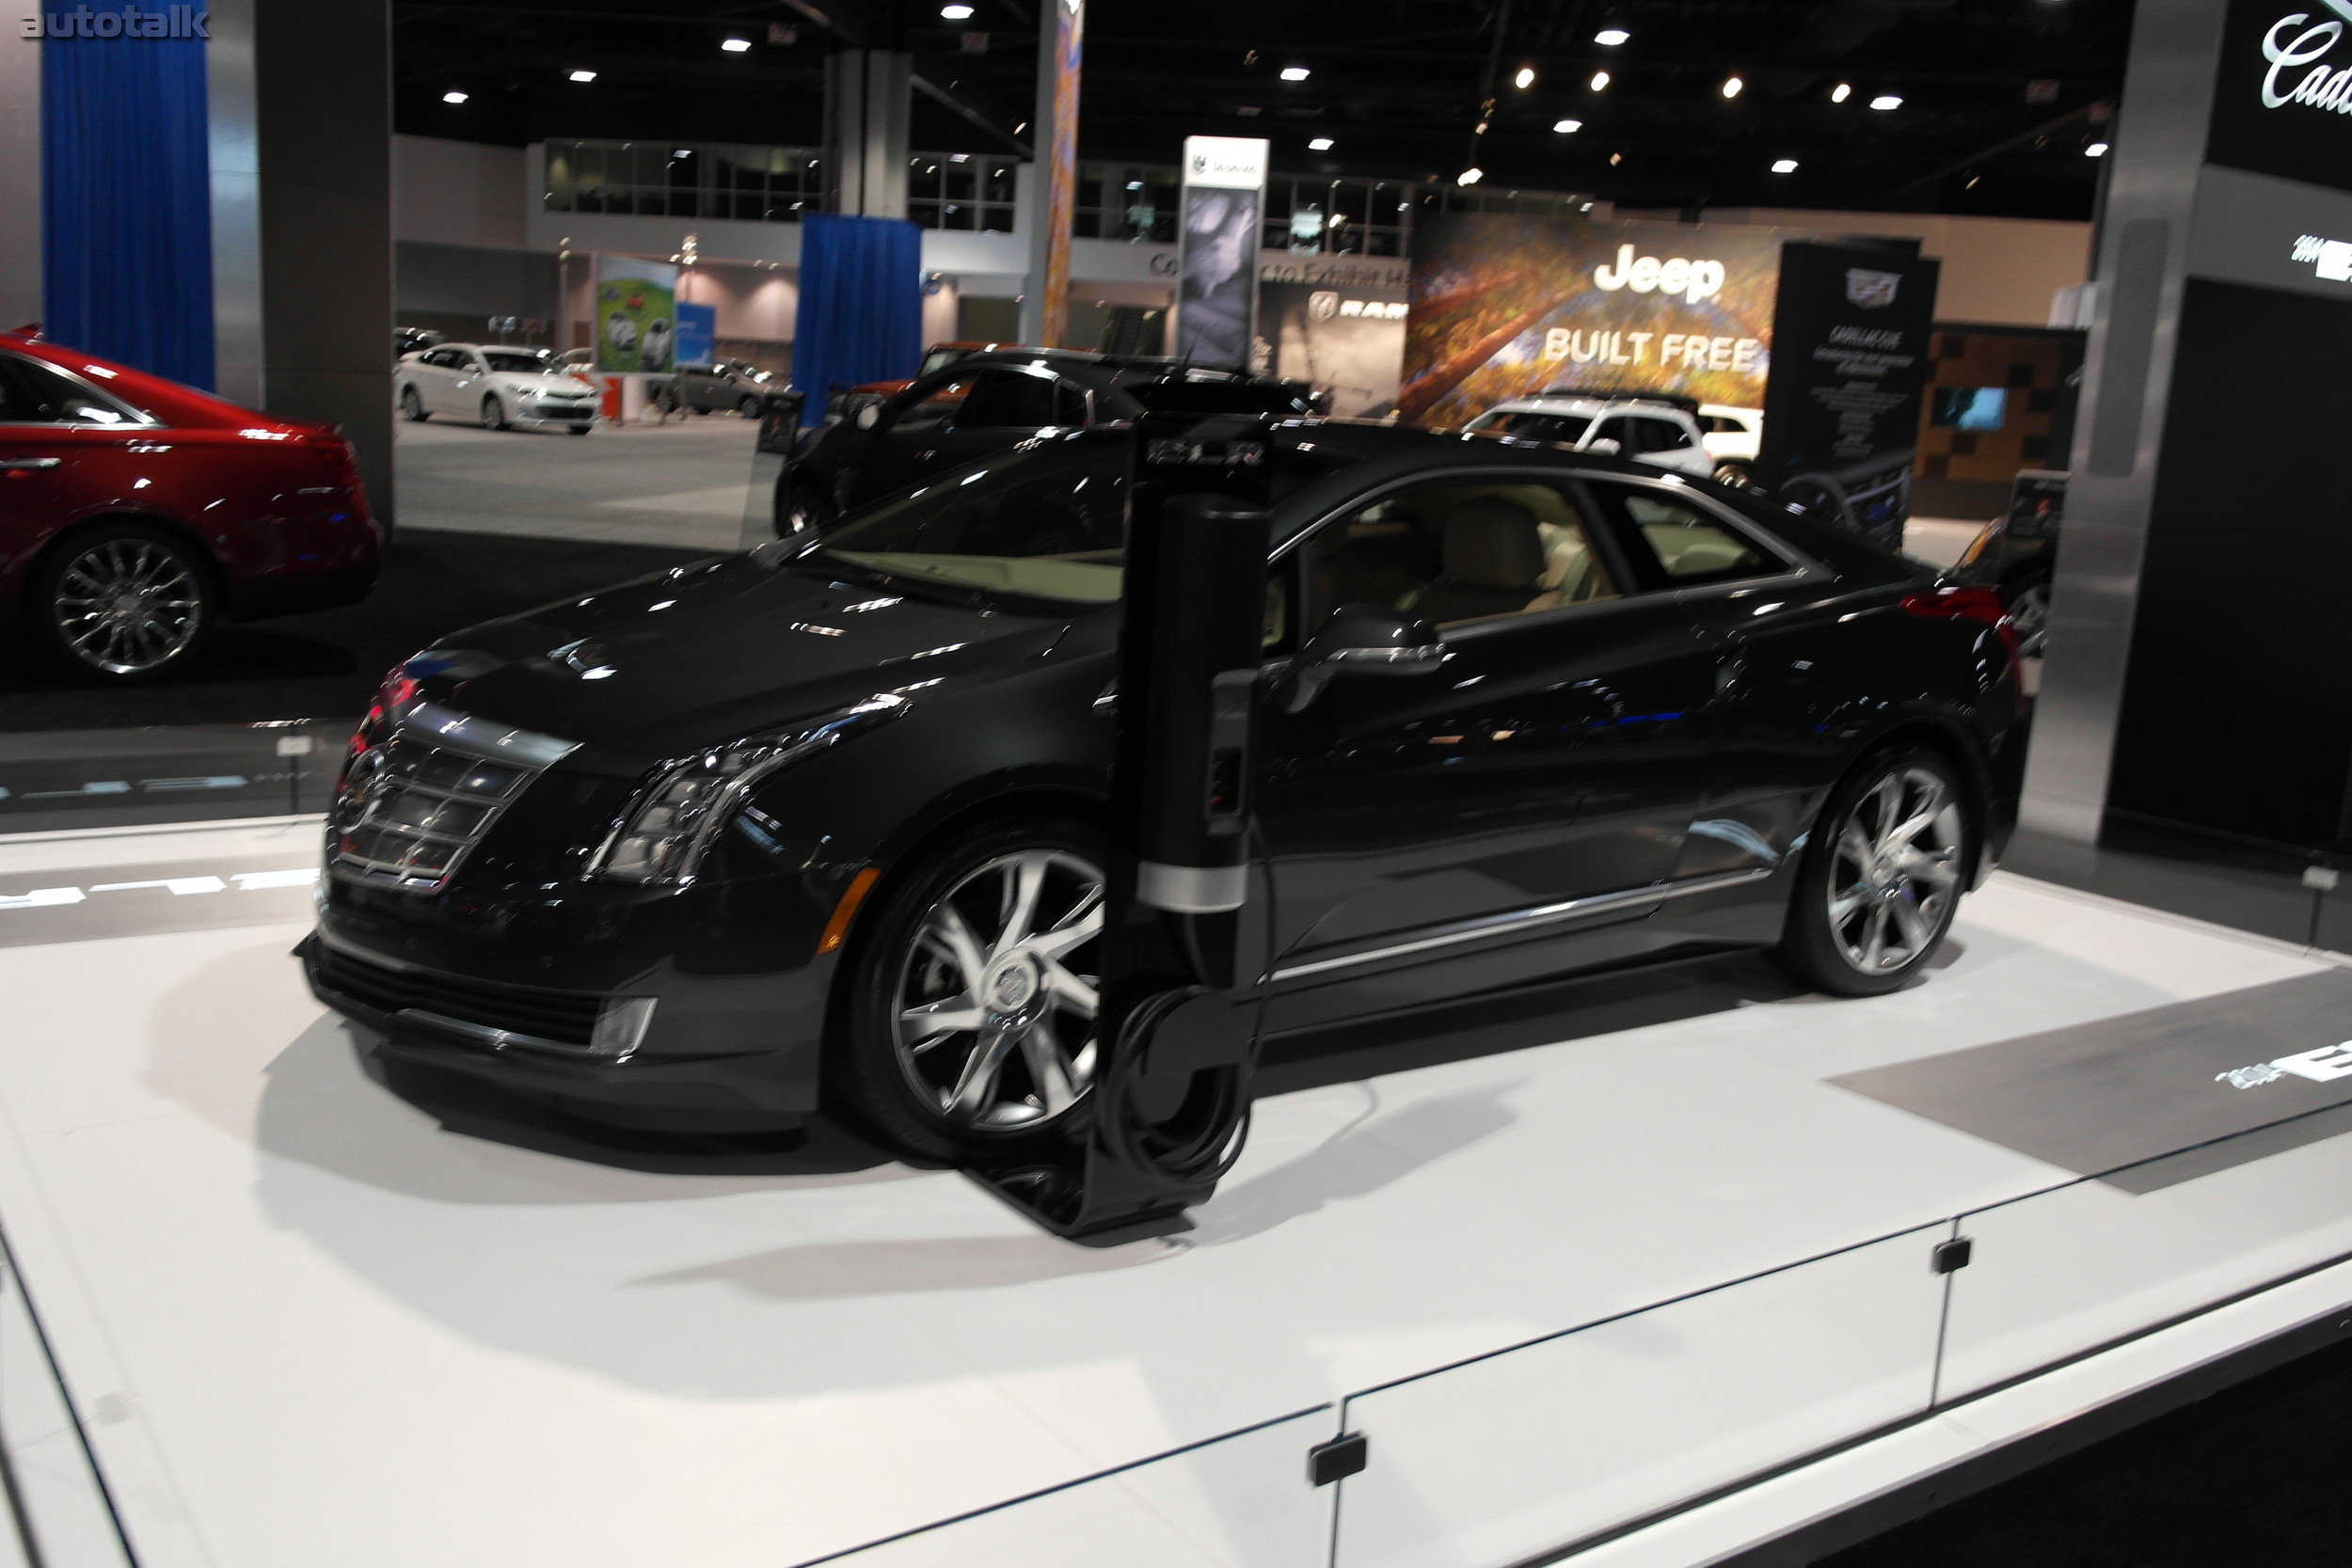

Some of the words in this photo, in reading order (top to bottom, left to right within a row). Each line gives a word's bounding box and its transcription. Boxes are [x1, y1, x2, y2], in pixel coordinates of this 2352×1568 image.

[2262, 13, 2352, 118] Cad
[1594, 244, 1725, 305] Jeep
[1339, 300, 1409, 320] RAM
[1544, 327, 1654, 366] BUILT
[1661, 334, 1758, 372] FREE
